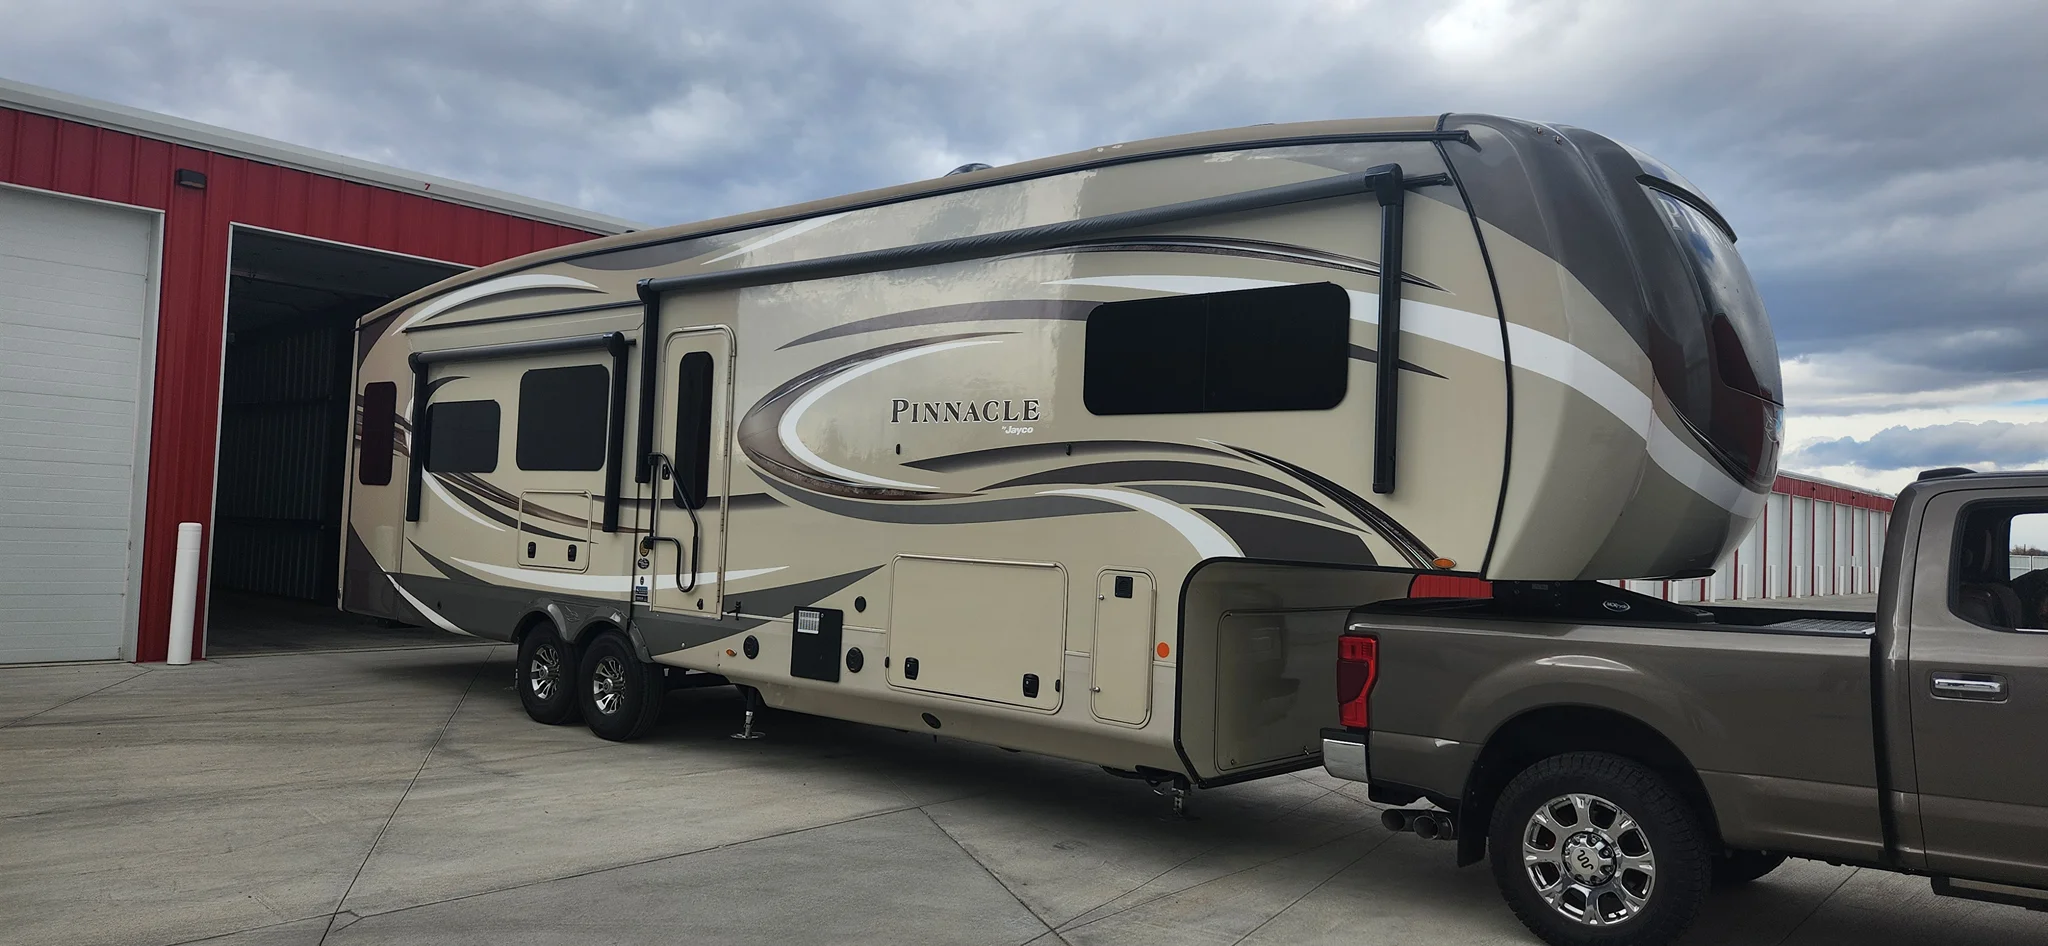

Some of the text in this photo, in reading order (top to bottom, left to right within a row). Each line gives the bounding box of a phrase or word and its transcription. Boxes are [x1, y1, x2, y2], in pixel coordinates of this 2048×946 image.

[424, 182, 431, 191] 7
[890, 399, 1040, 423] PINNACLE
[1005, 425, 1034, 436] Jayco
